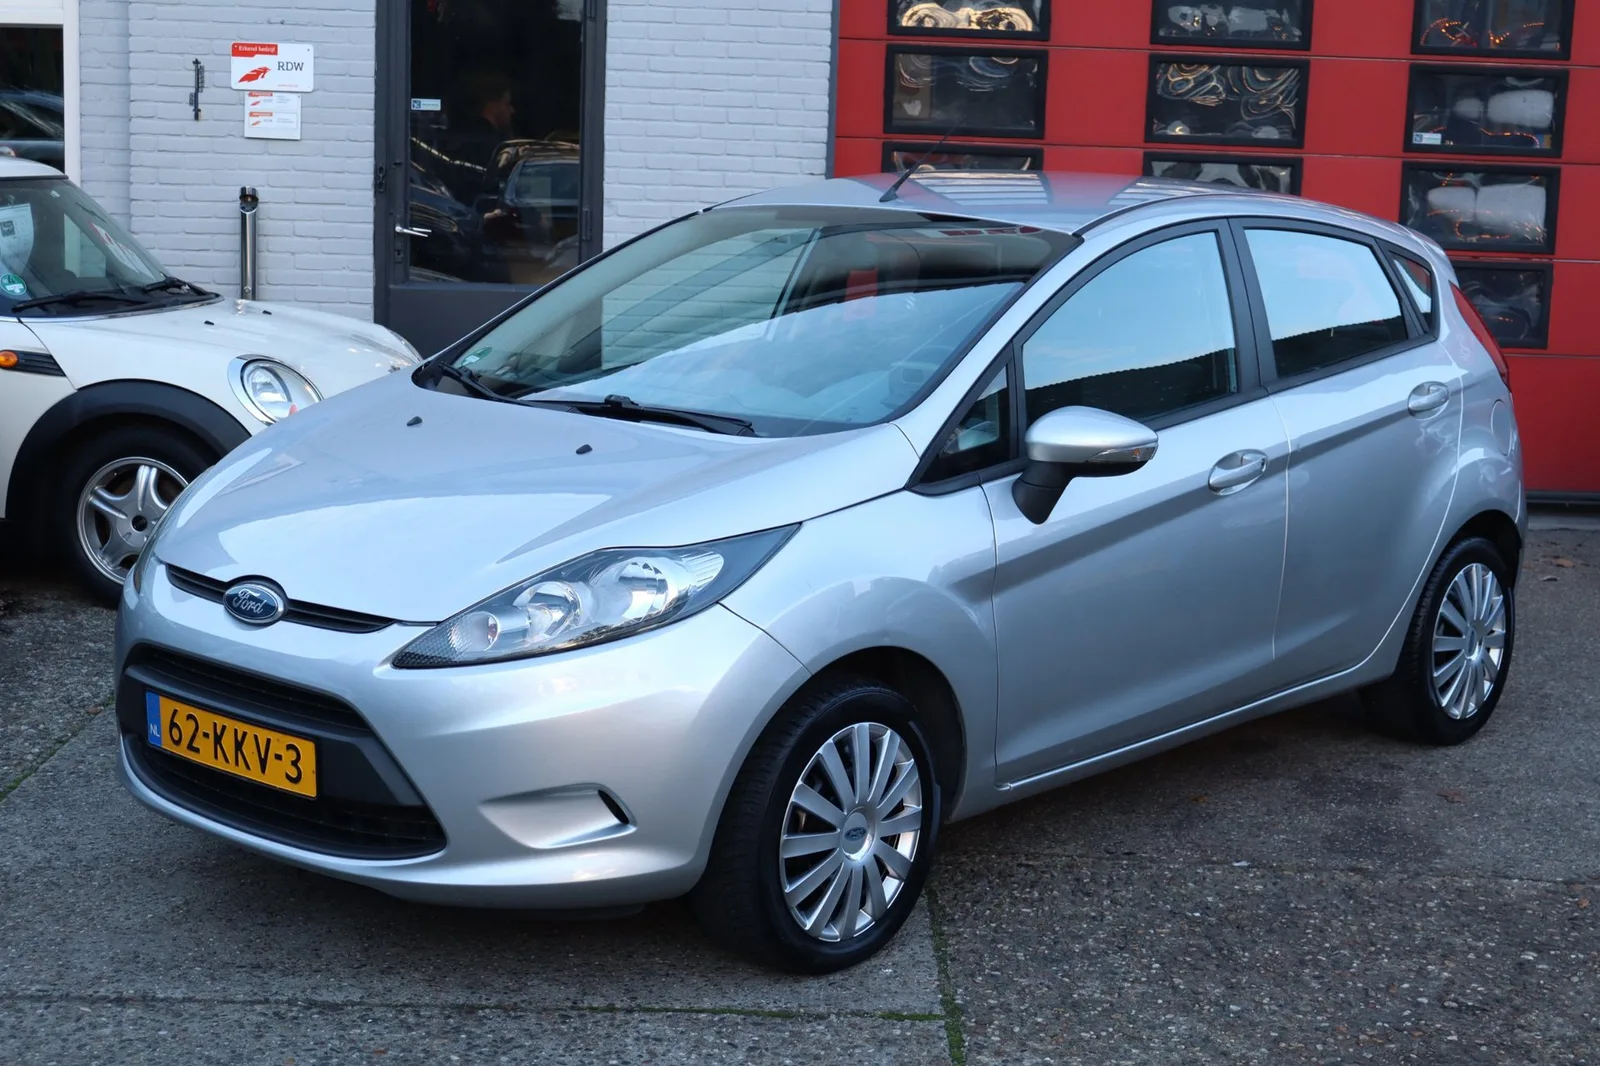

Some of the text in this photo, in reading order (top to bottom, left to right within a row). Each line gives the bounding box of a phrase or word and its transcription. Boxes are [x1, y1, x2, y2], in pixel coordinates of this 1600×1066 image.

[277, 61, 304, 71] RDW
[232, 588, 267, 614] Ford
[149, 723, 160, 738] NL
[168, 708, 303, 785] 62-KKV-3
